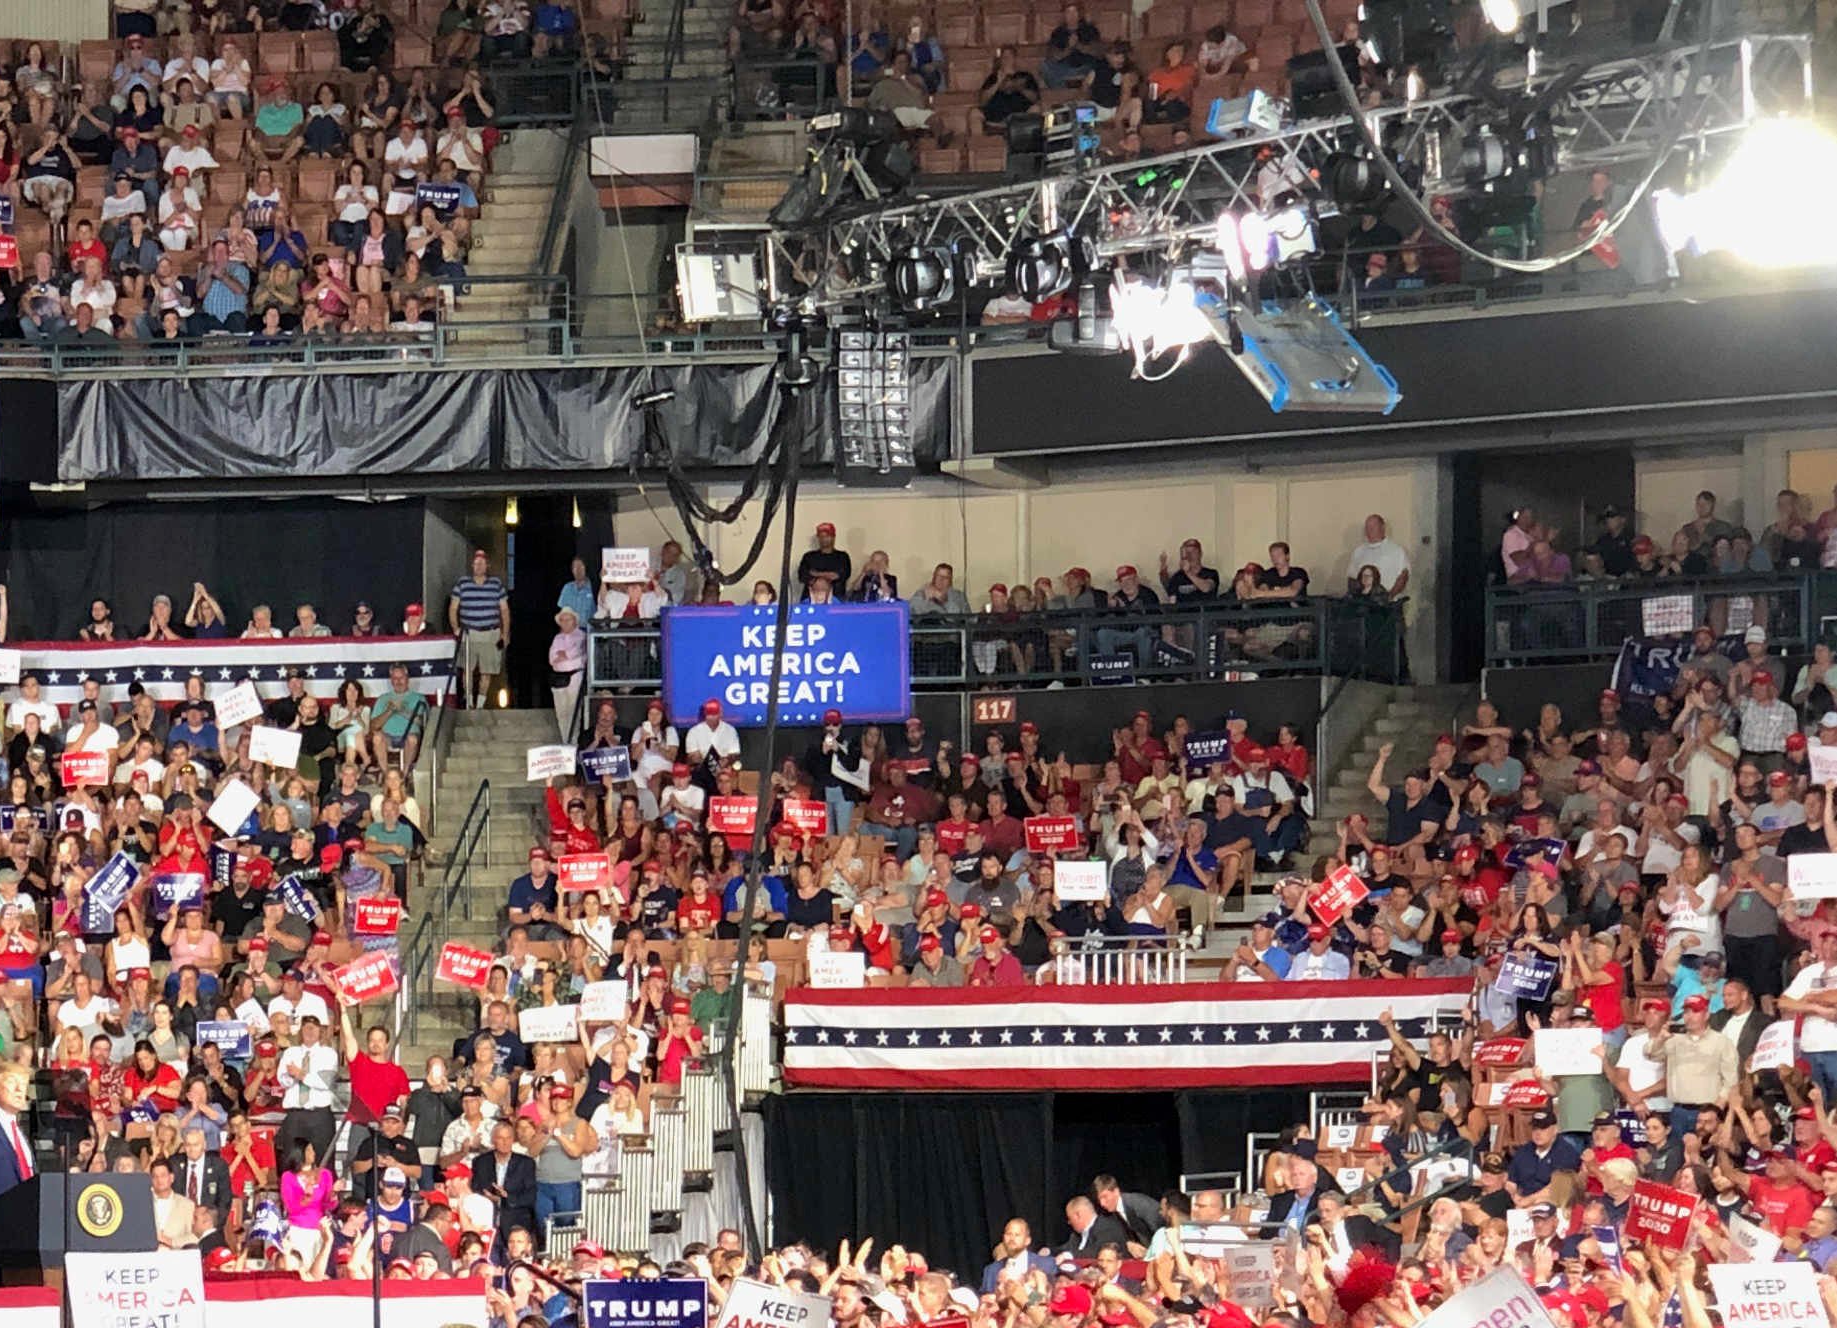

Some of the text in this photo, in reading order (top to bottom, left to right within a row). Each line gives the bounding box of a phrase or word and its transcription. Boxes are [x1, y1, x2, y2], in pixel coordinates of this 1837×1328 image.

[420, 190, 460, 199] TRUMP
[742, 625, 826, 648] KEEP
[709, 651, 861, 677] AMERICA
[1091, 661, 1129, 669] TRUMP
[725, 680, 844, 705] GREAT!
[978, 701, 1012, 720] 117
[1187, 739, 1228, 750] TRUMP
[584, 754, 626, 766] TRUMP
[713, 805, 758, 814] TRUMP
[1028, 823, 1074, 833] TRUMP
[562, 861, 607, 871] TRUMP
[1313, 873, 1352, 907] TRUMP
[283, 881, 310, 918] TRUMP
[359, 905, 398, 914] TRUMP
[444, 950, 488, 968] TRUMP
[339, 958, 387, 984] TRUMP
[1506, 962, 1551, 980] TRUMP
[200, 1029, 247, 1039] TRUMP
[1634, 1193, 1691, 1219] TRUMP
[1637, 1216, 1671, 1234] 2020
[106, 1269, 160, 1285] KEEP
[1743, 1279, 1787, 1296] KEEP
[589, 1300, 701, 1318] TRUMP
[759, 1298, 809, 1325] KEEP
[1728, 1301, 1820, 1322] AMERICA
